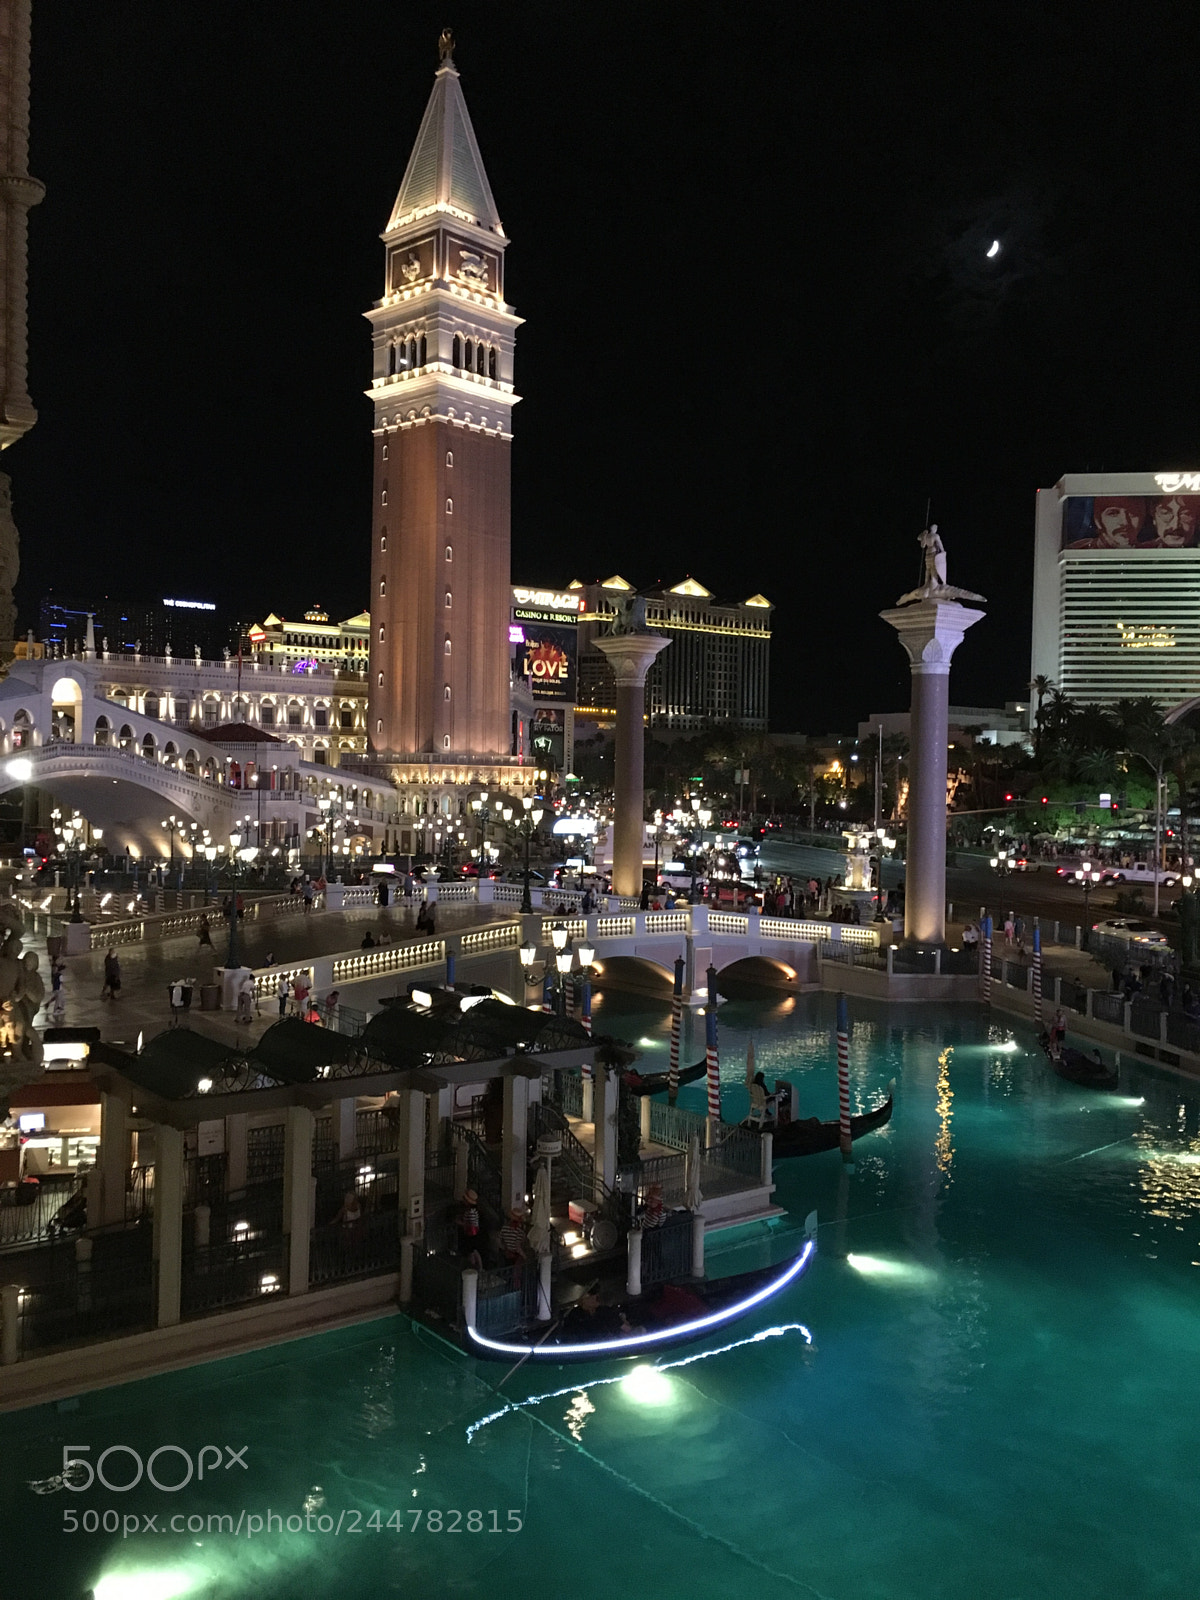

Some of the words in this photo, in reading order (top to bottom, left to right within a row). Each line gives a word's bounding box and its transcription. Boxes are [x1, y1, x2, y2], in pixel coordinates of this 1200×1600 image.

[523, 590, 580, 609] MIRAGE
[515, 609, 542, 619] CASINO
[550, 613, 577, 623] RESORT
[523, 658, 569, 678] LOVE
